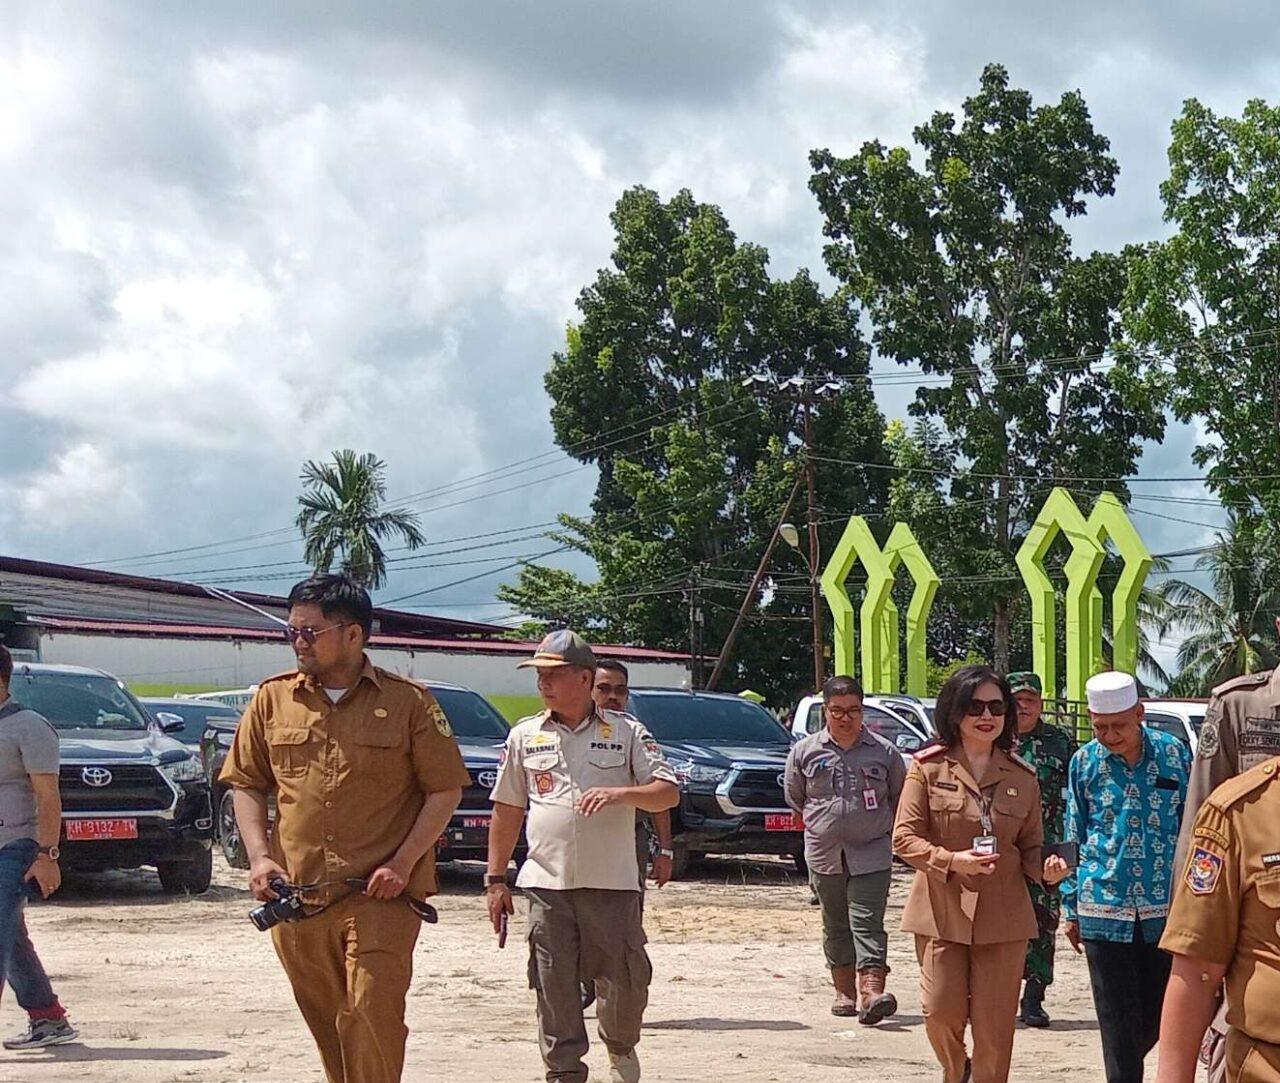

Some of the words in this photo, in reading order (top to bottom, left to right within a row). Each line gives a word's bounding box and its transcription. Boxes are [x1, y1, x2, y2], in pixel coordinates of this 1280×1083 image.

[590, 742, 608, 750] POL
[610, 743, 623, 751] PP
[68, 821, 82, 834] KH
